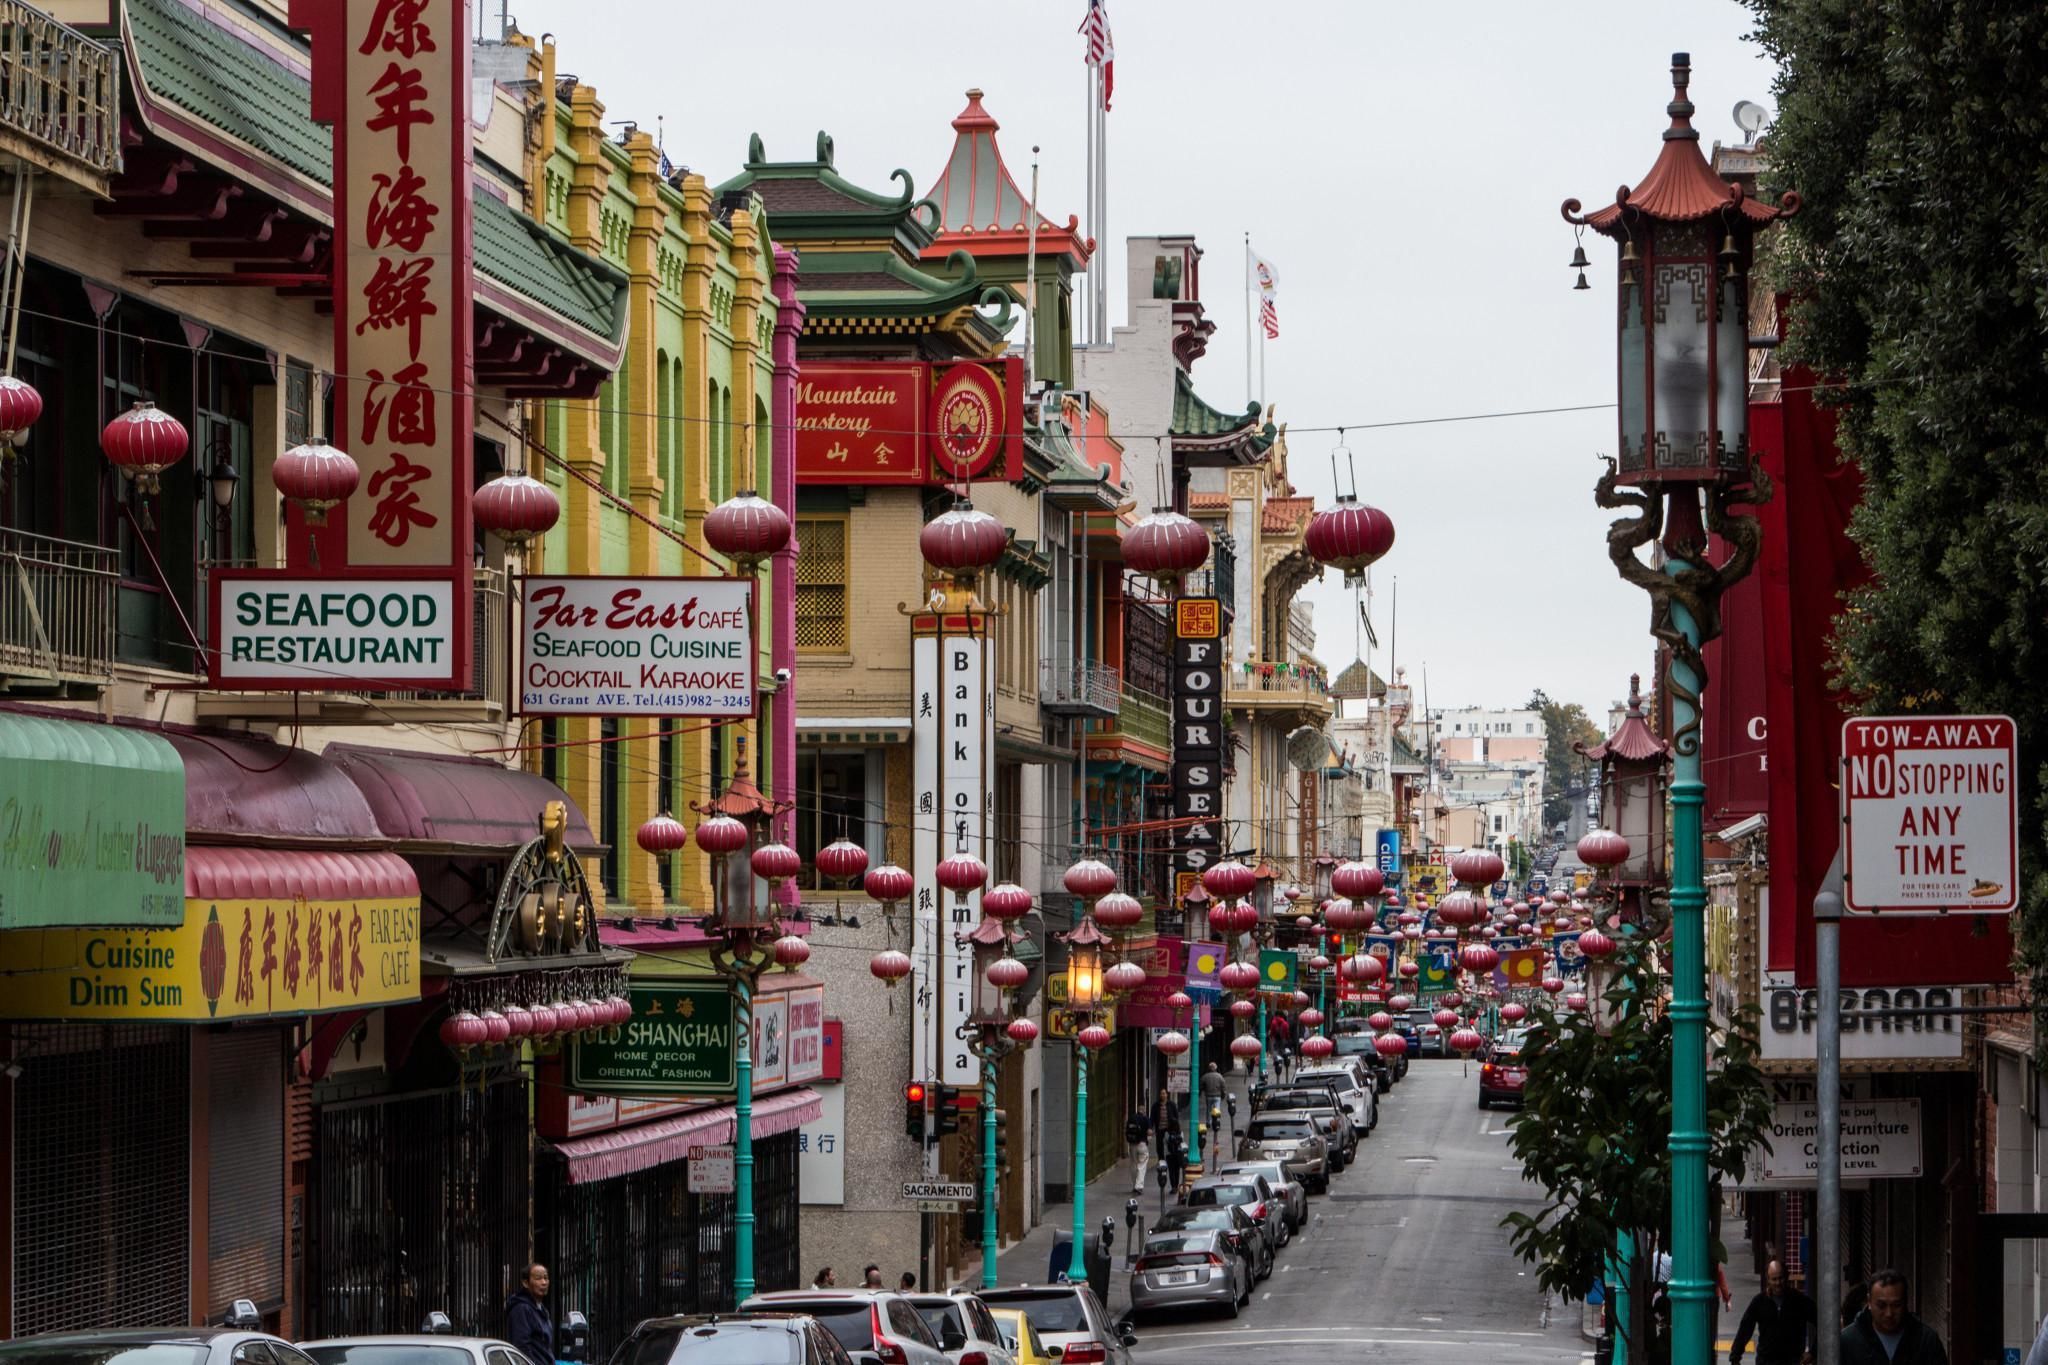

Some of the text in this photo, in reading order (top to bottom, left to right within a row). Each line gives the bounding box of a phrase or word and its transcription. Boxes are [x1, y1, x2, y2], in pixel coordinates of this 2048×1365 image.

[236, 592, 437, 627] SEAFOOD
[530, 585, 743, 630] Far East CAFÉ
[232, 636, 445, 664] RESTAURANT
[523, 693, 545, 706] 631
[549, 693, 589, 706] Grant
[597, 693, 630, 706] AVE.
[954, 651, 968, 761] Bank
[1185, 643, 1211, 745] FOUR
[1857, 725, 2002, 747] TOW-AWAY
[1852, 754, 2004, 796] NO STOPPING
[1900, 806, 1962, 836] ANY
[144, 823, 183, 885] Luggage
[1895, 845, 1966, 875] TIME
[370, 908, 391, 944] FAR
[85, 939, 175, 970] Cuisine
[70, 977, 182, 1006] Dim Sum
[952, 909, 970, 1068] merica
[628, 1022, 728, 1047] SHANGHAI
[614, 1051, 696, 1062] HOME DECOR
[651, 1061, 658, 1069] &
[598, 1067, 711, 1078] ORIENTAL FASHION
[704, 1150, 733, 1159] PARKING
[1845, 1161, 1877, 1169] LEVEL
[904, 1185, 972, 1197] SACRAMENTO
